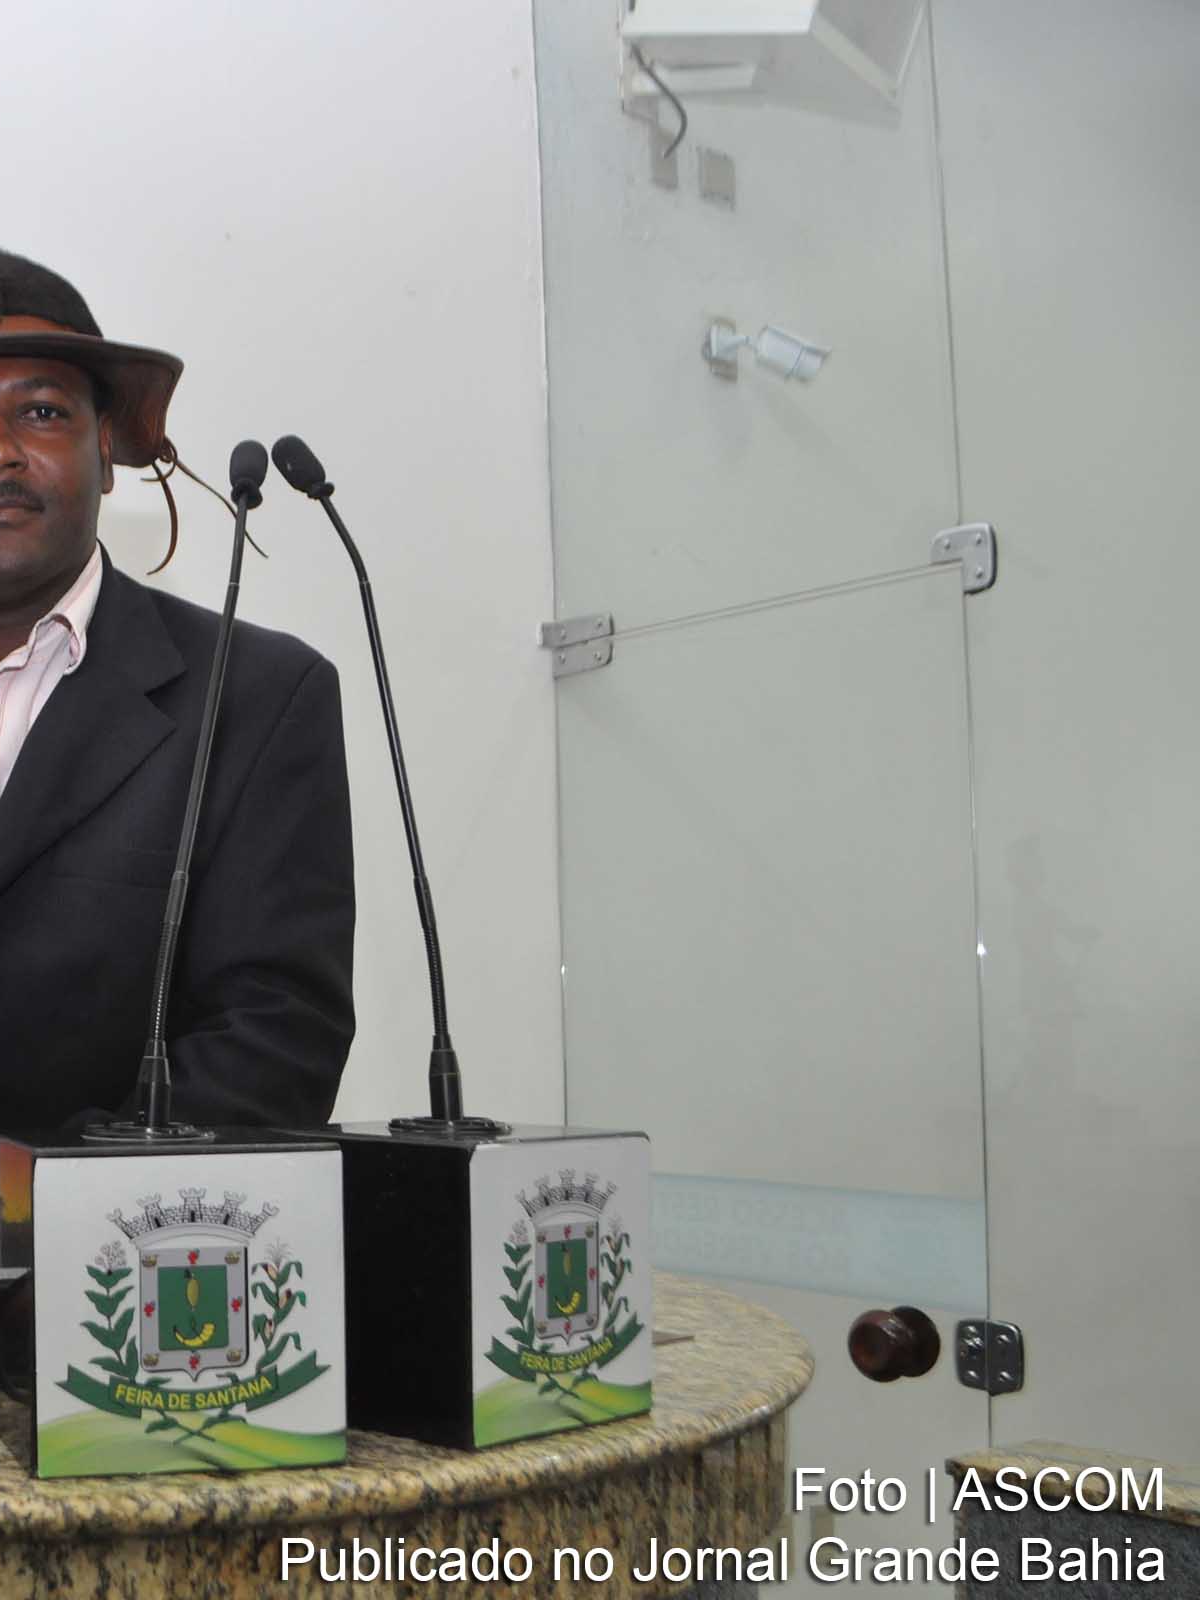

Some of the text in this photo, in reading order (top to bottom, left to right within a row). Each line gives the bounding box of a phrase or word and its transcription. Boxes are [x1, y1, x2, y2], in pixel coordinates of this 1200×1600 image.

[550, 1356, 566, 1373] DE
[115, 1375, 272, 1409] FEIRA DE SANTANA
